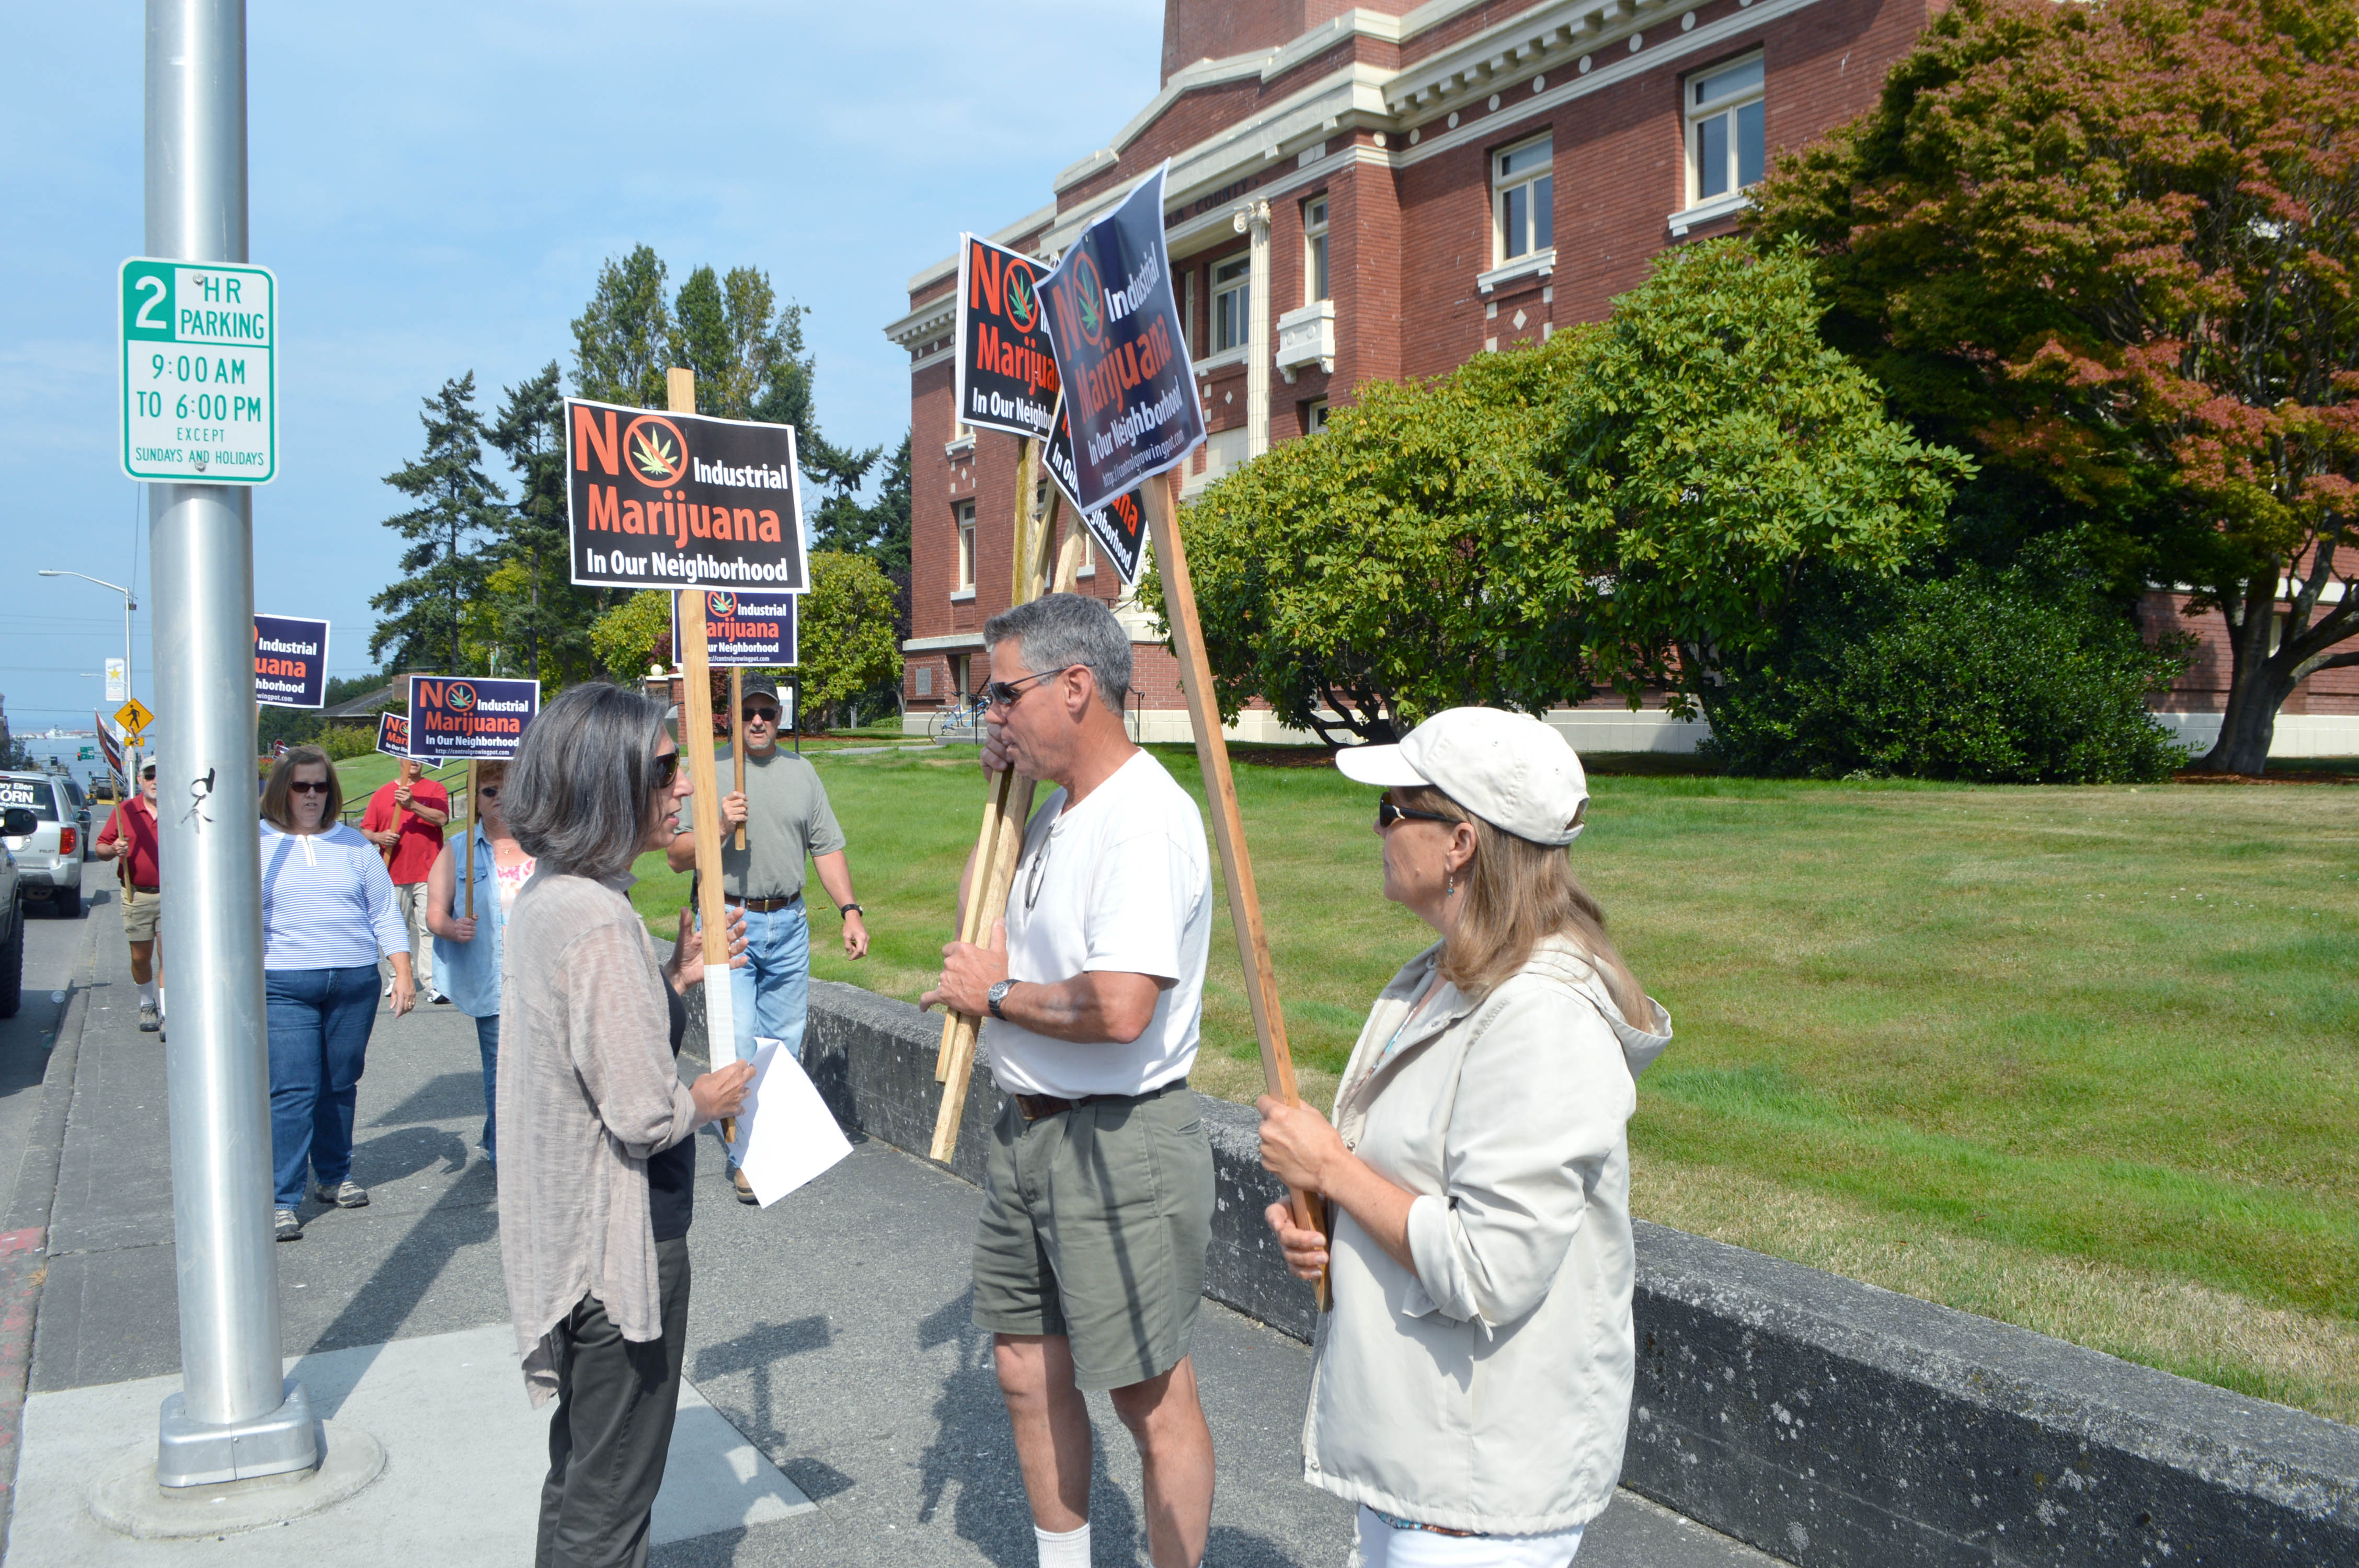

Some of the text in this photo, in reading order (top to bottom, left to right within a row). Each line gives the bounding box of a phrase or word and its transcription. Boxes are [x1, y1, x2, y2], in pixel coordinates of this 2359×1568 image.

[204, 276, 241, 304] HR
[1104, 241, 1160, 323] Industrial
[135, 275, 167, 329] 2
[180, 309, 265, 339] PARKING
[152, 354, 245, 384] 9:00 AM
[1074, 314, 1173, 423] Marijuana
[136, 391, 261, 422] TO 6:00 PM
[972, 387, 987, 414] In
[990, 391, 1014, 420] Our
[1016, 397, 1053, 433] Neighbo
[1087, 375, 1183, 466] In Our Neighborhood
[177, 427, 225, 442] EXCEPT
[135, 447, 264, 466] SUNDAYS AND HOLIDAYS
[1052, 442, 1063, 471] In
[1102, 429, 1185, 488] http://controlgrowingpot.com
[693, 456, 788, 490] Industrial
[588, 483, 782, 549] Marijuana
[586, 547, 788, 583] In Our Neighborhood
[738, 603, 786, 616] Industrial
[707, 617, 780, 643] arijuana
[259, 637, 317, 655] Industrial
[708, 642, 779, 654] ur Neighborhood
[256, 678, 305, 694] hborhood
[477, 699, 529, 712] Industrial
[425, 711, 520, 736] Marijuana
[426, 735, 519, 747] In Our Neighborhood
[436, 748, 510, 756] http://controlgrowingpot.com
